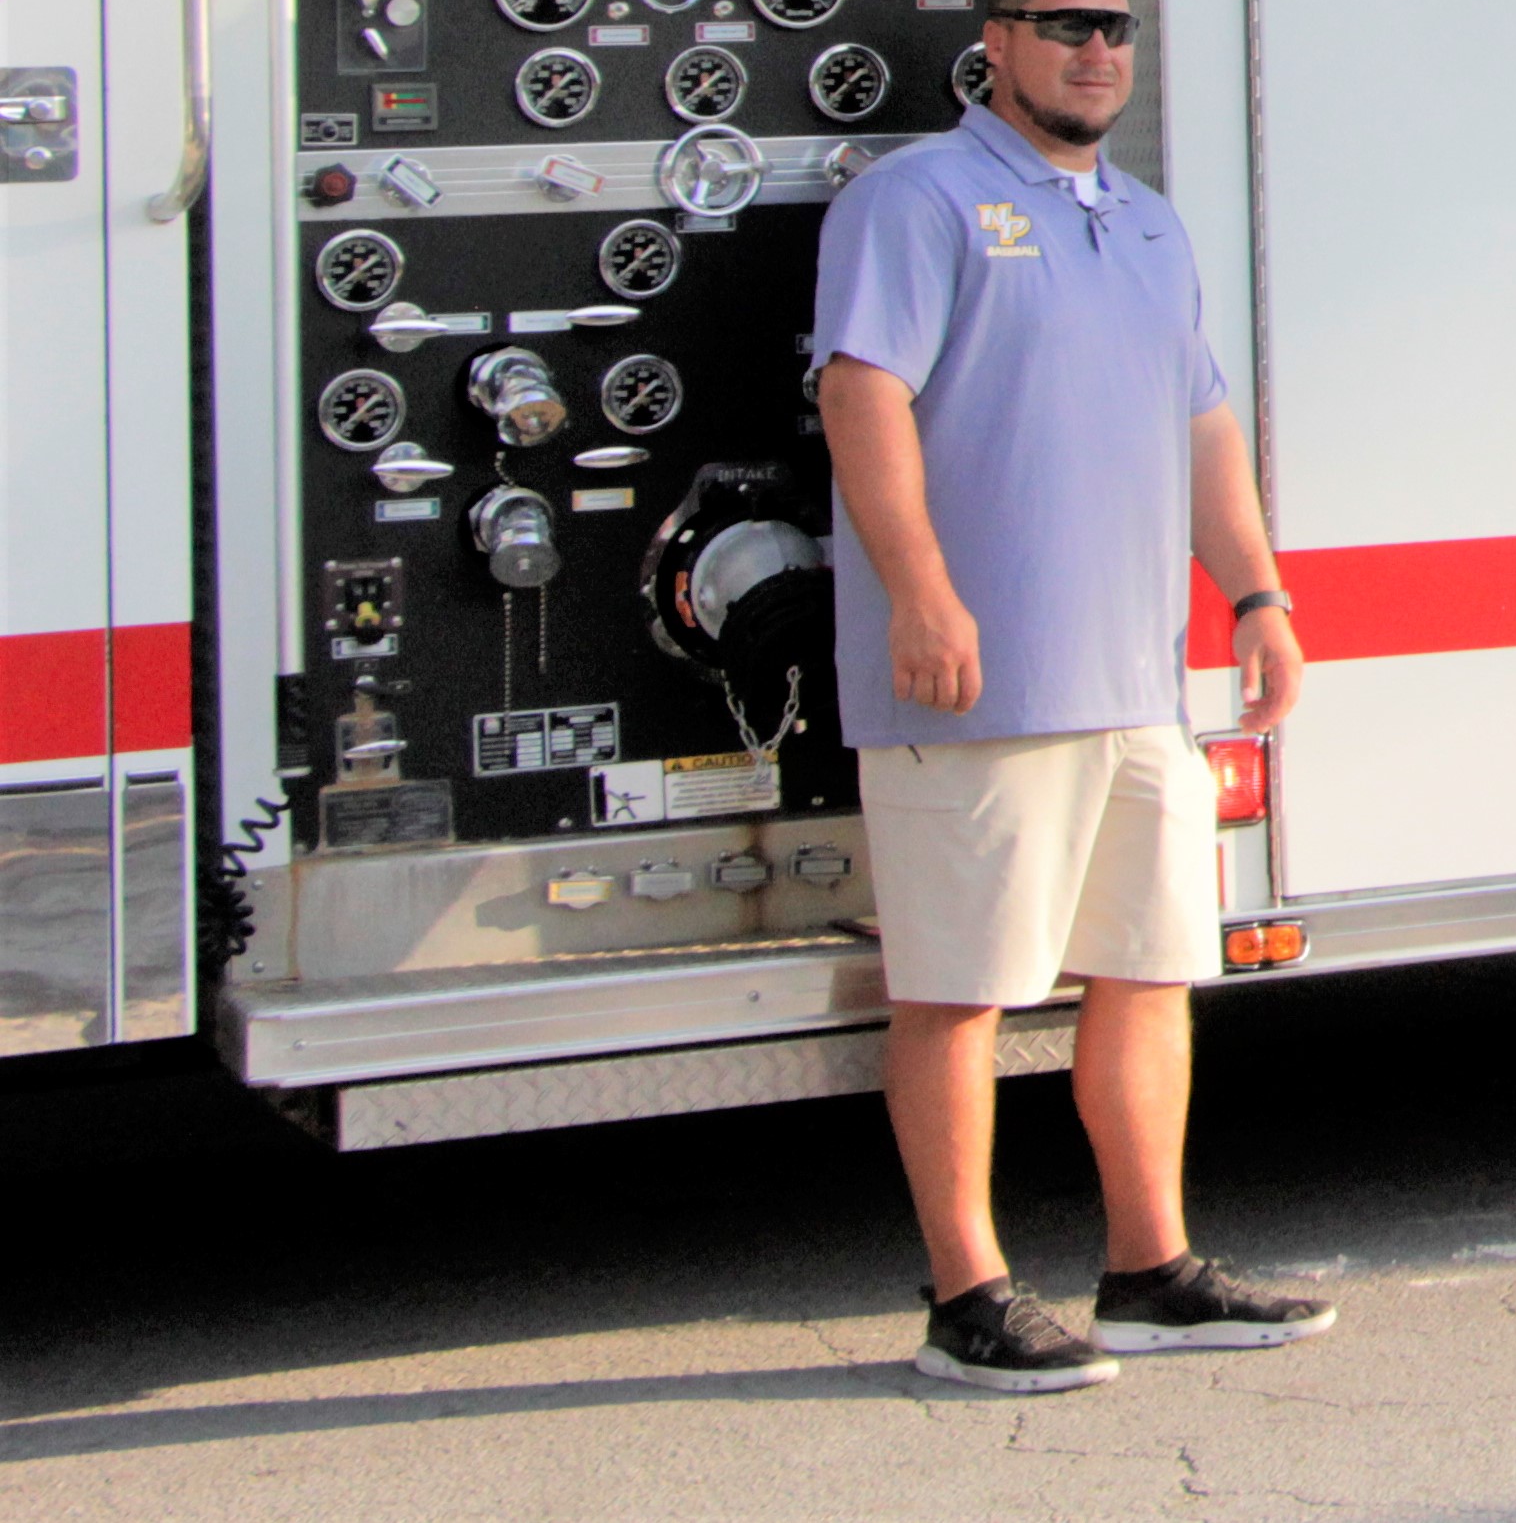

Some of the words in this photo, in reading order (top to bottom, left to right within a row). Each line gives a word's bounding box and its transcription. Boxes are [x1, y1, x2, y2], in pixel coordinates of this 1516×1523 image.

[975, 201, 1032, 247] NP
[985, 245, 1042, 258] BASEBALL
[692, 752, 758, 768] CAUTIO
